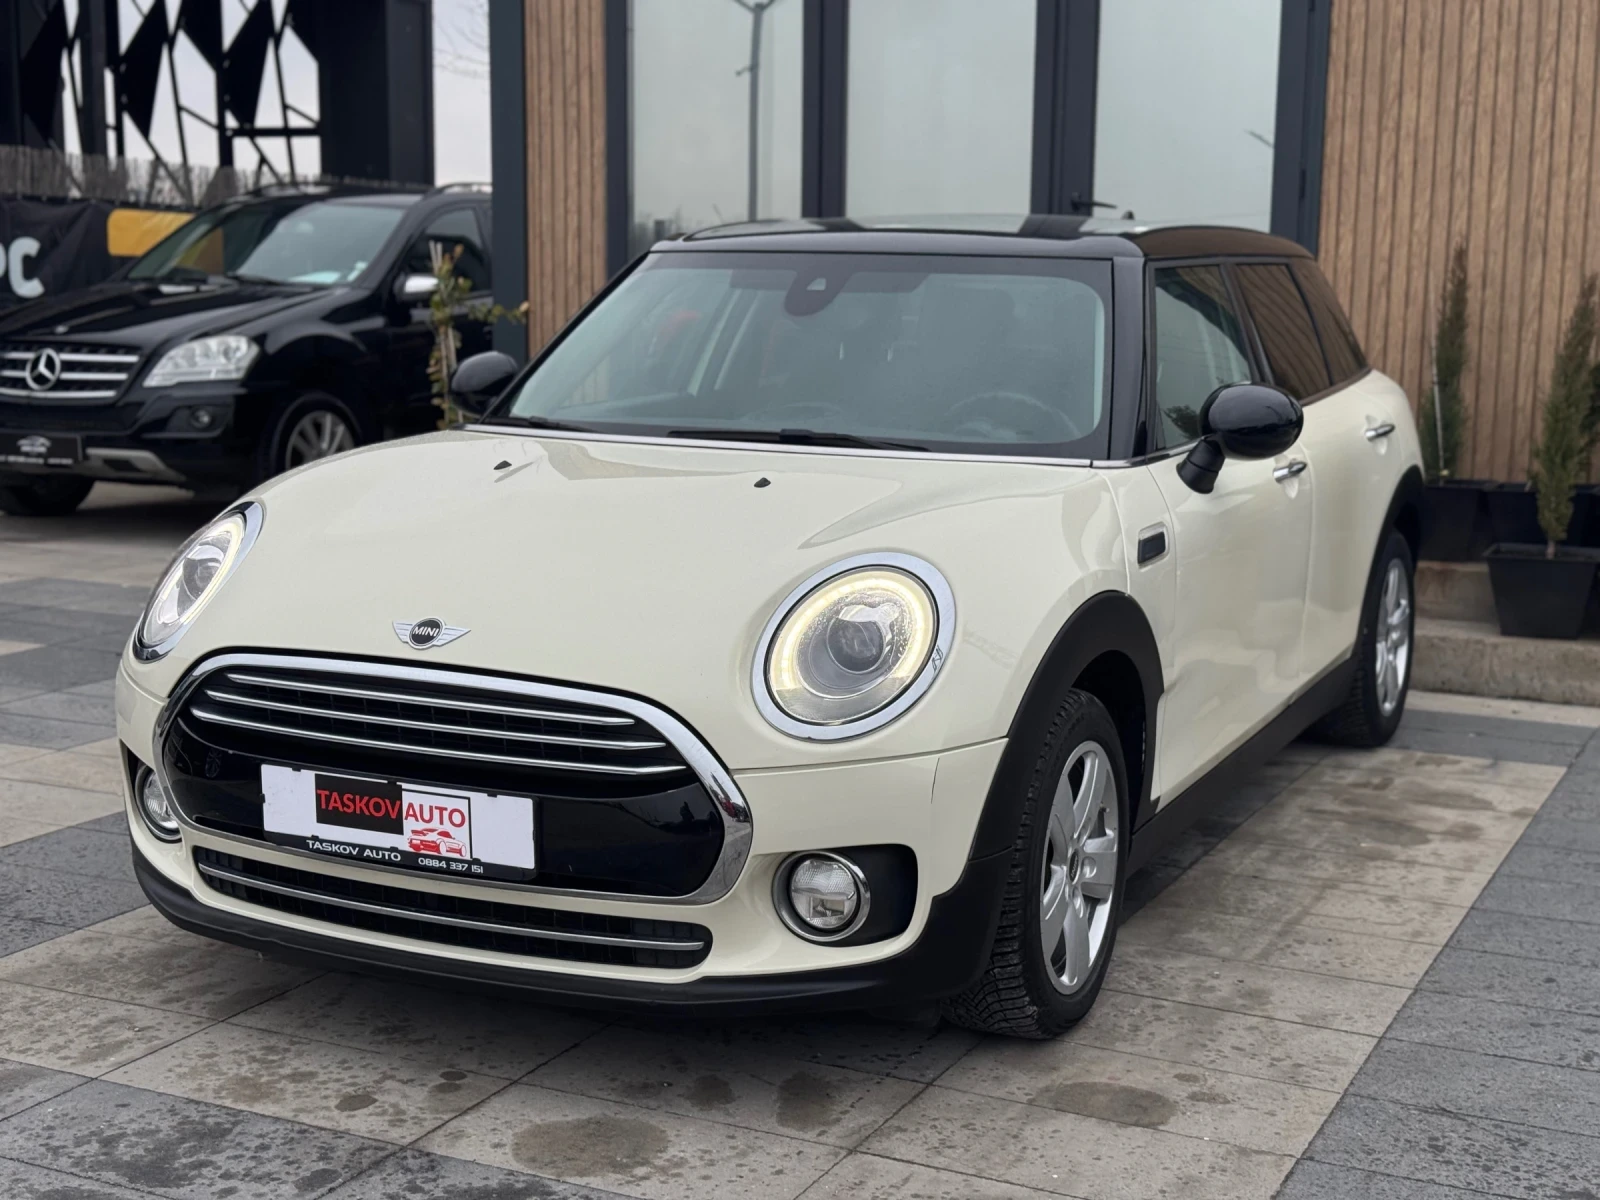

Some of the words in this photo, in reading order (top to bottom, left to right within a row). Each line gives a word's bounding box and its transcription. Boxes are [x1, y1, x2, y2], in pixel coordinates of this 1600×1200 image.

[0, 236, 45, 298] C
[412, 626, 440, 637] MINI
[317, 789, 401, 819] TASKOV
[404, 803, 466, 828] AUTO
[306, 839, 359, 856] TASKOV
[363, 848, 401, 861] AUTO
[418, 857, 447, 869] 0884
[449, 861, 469, 872] 337
[471, 865, 484, 874] 151
